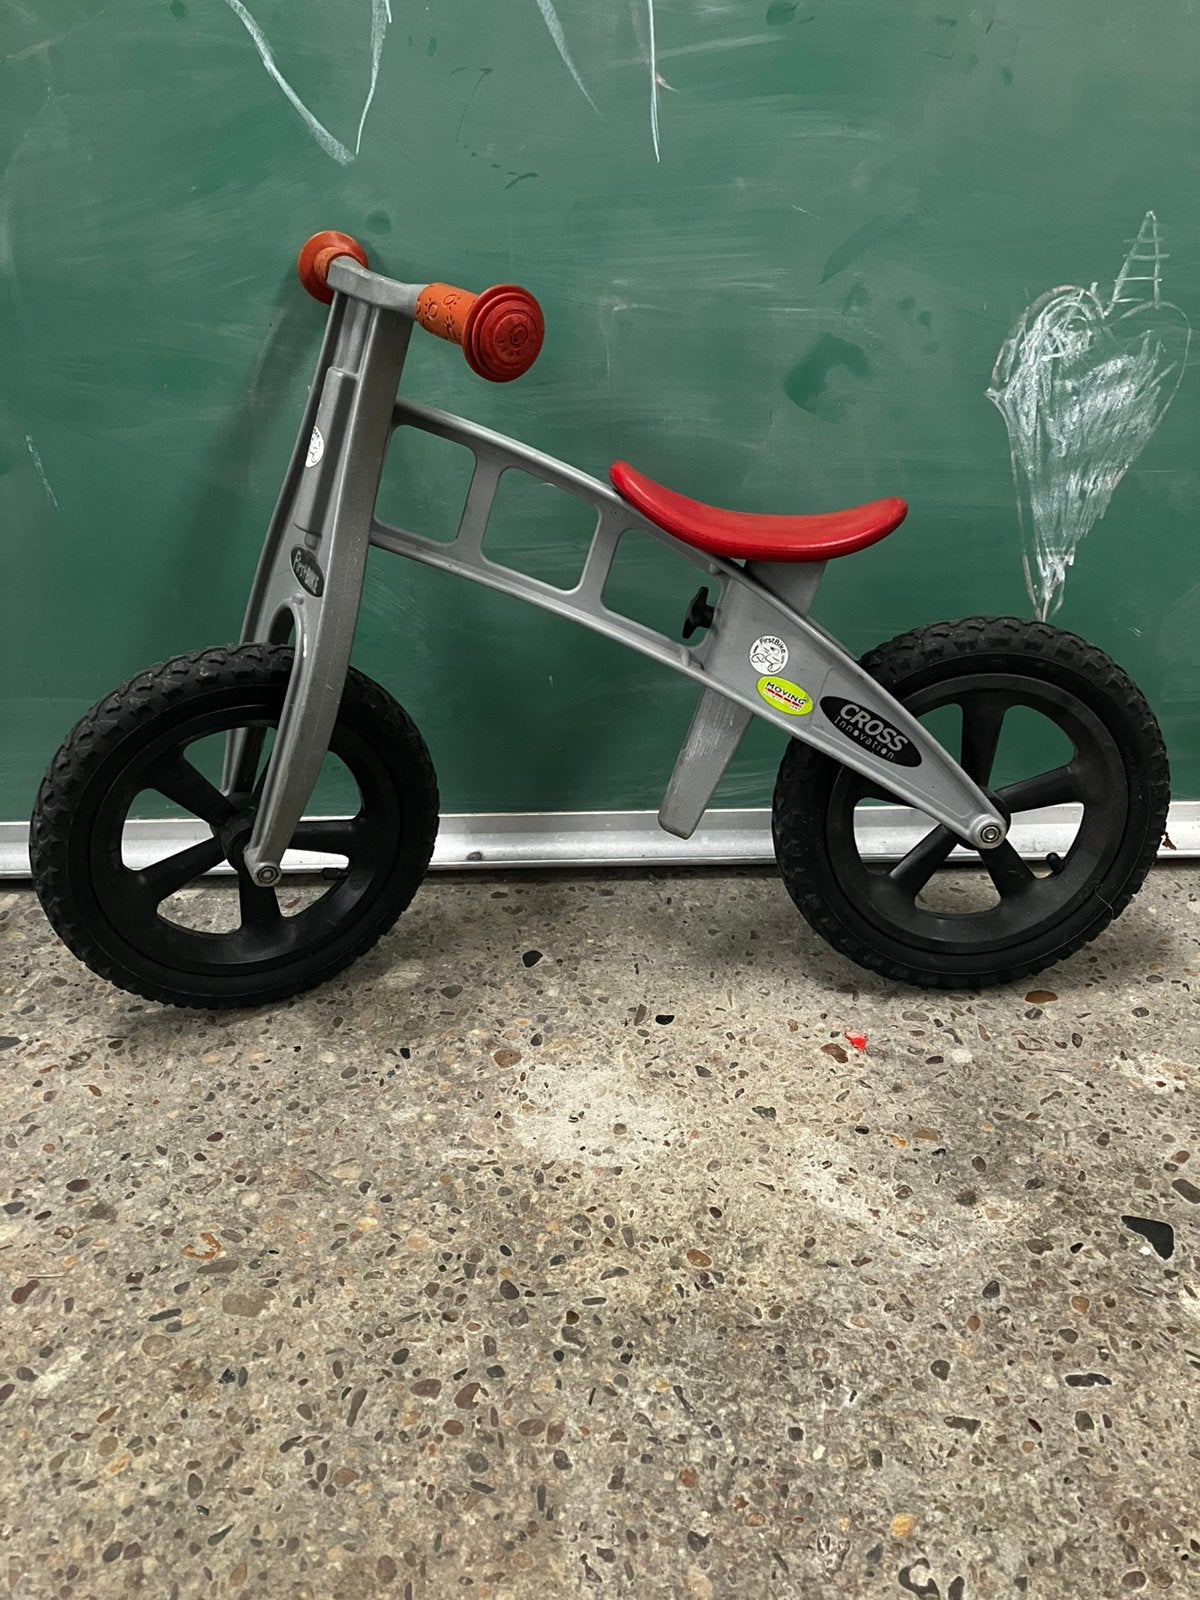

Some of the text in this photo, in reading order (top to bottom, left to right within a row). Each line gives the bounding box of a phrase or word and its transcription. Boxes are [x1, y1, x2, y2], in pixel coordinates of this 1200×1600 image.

[759, 637, 786, 654] FirstBike
[766, 681, 806, 705] MOVING
[834, 715, 894, 759] Innovation
[840, 704, 909, 751] CROSS
